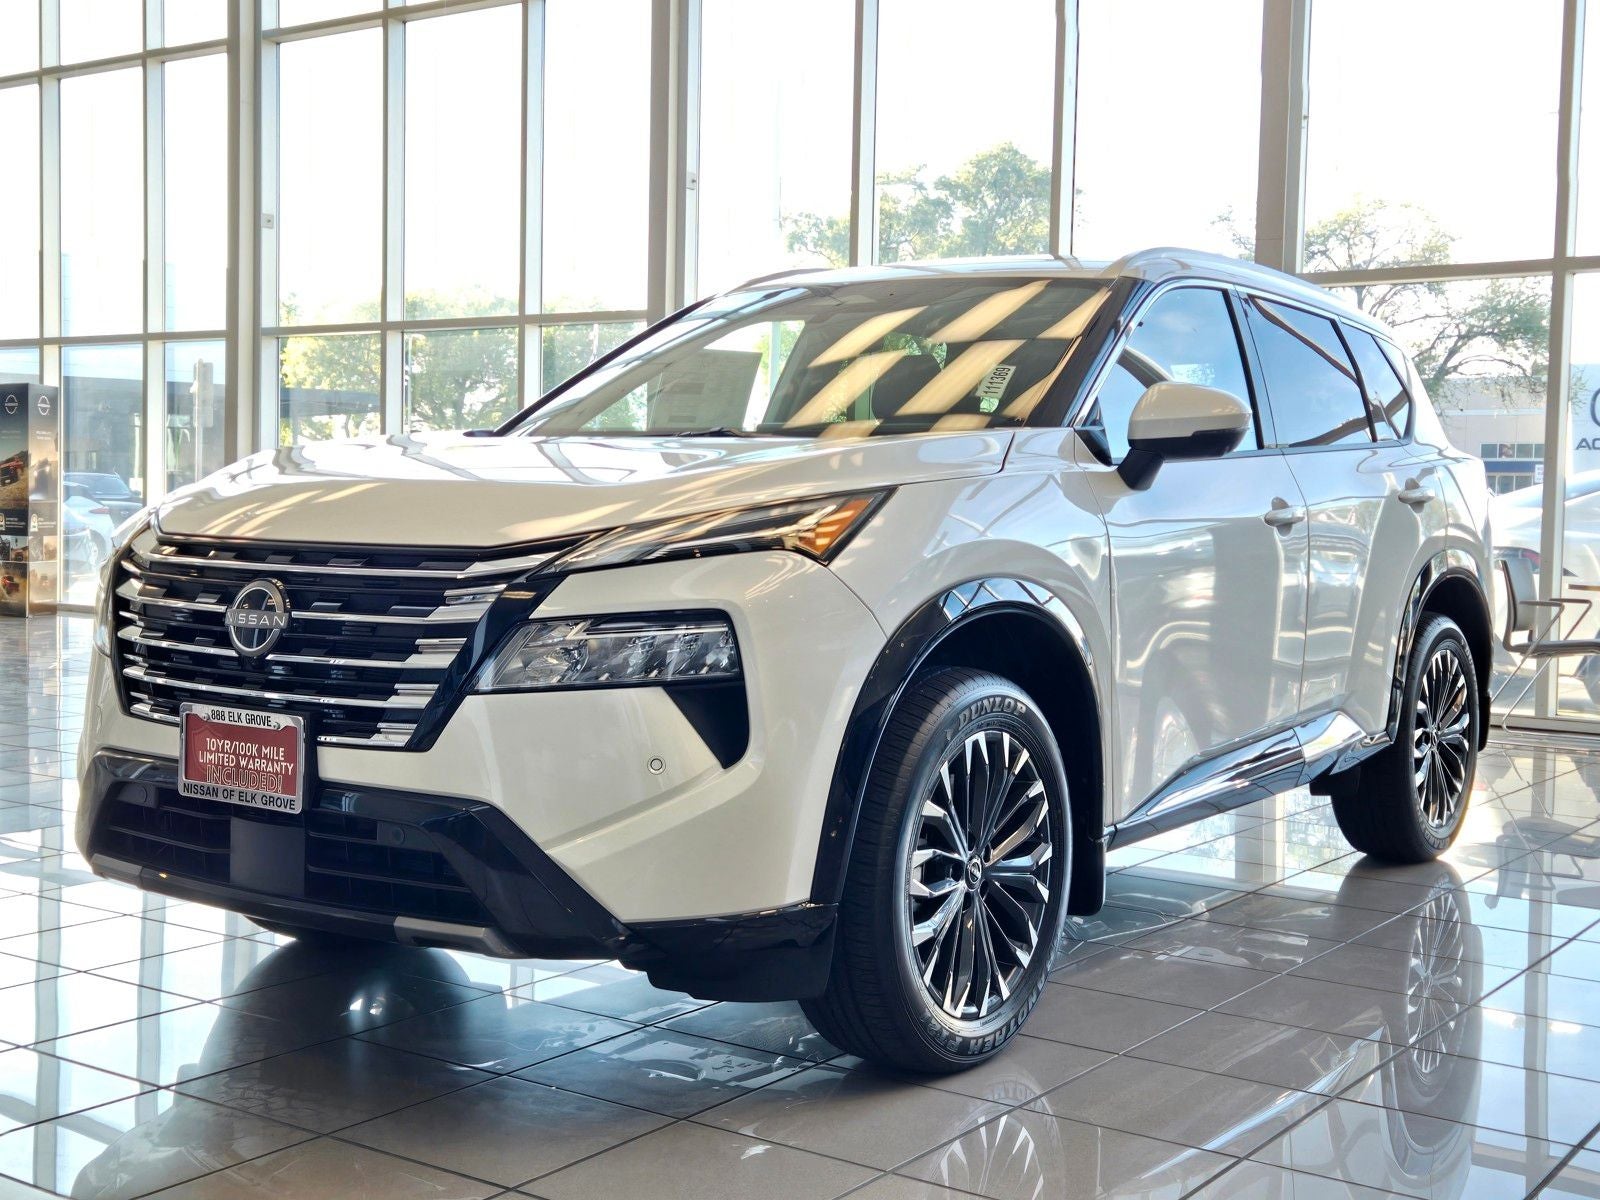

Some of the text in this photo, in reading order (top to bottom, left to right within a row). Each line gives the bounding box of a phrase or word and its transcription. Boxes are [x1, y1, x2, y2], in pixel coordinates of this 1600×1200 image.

[984, 367, 1010, 395] 111369
[227, 611, 286, 627] NISSAN
[211, 709, 272, 727] 888 ELK GROVE
[959, 697, 1027, 731] DUNLOP
[206, 738, 285, 760] 10YR/100K MILE
[199, 751, 294, 776] LIMITED WARRANTY
[206, 765, 283, 793] INCLUDED!
[183, 783, 296, 810] NISSAN OF ELK GROVE
